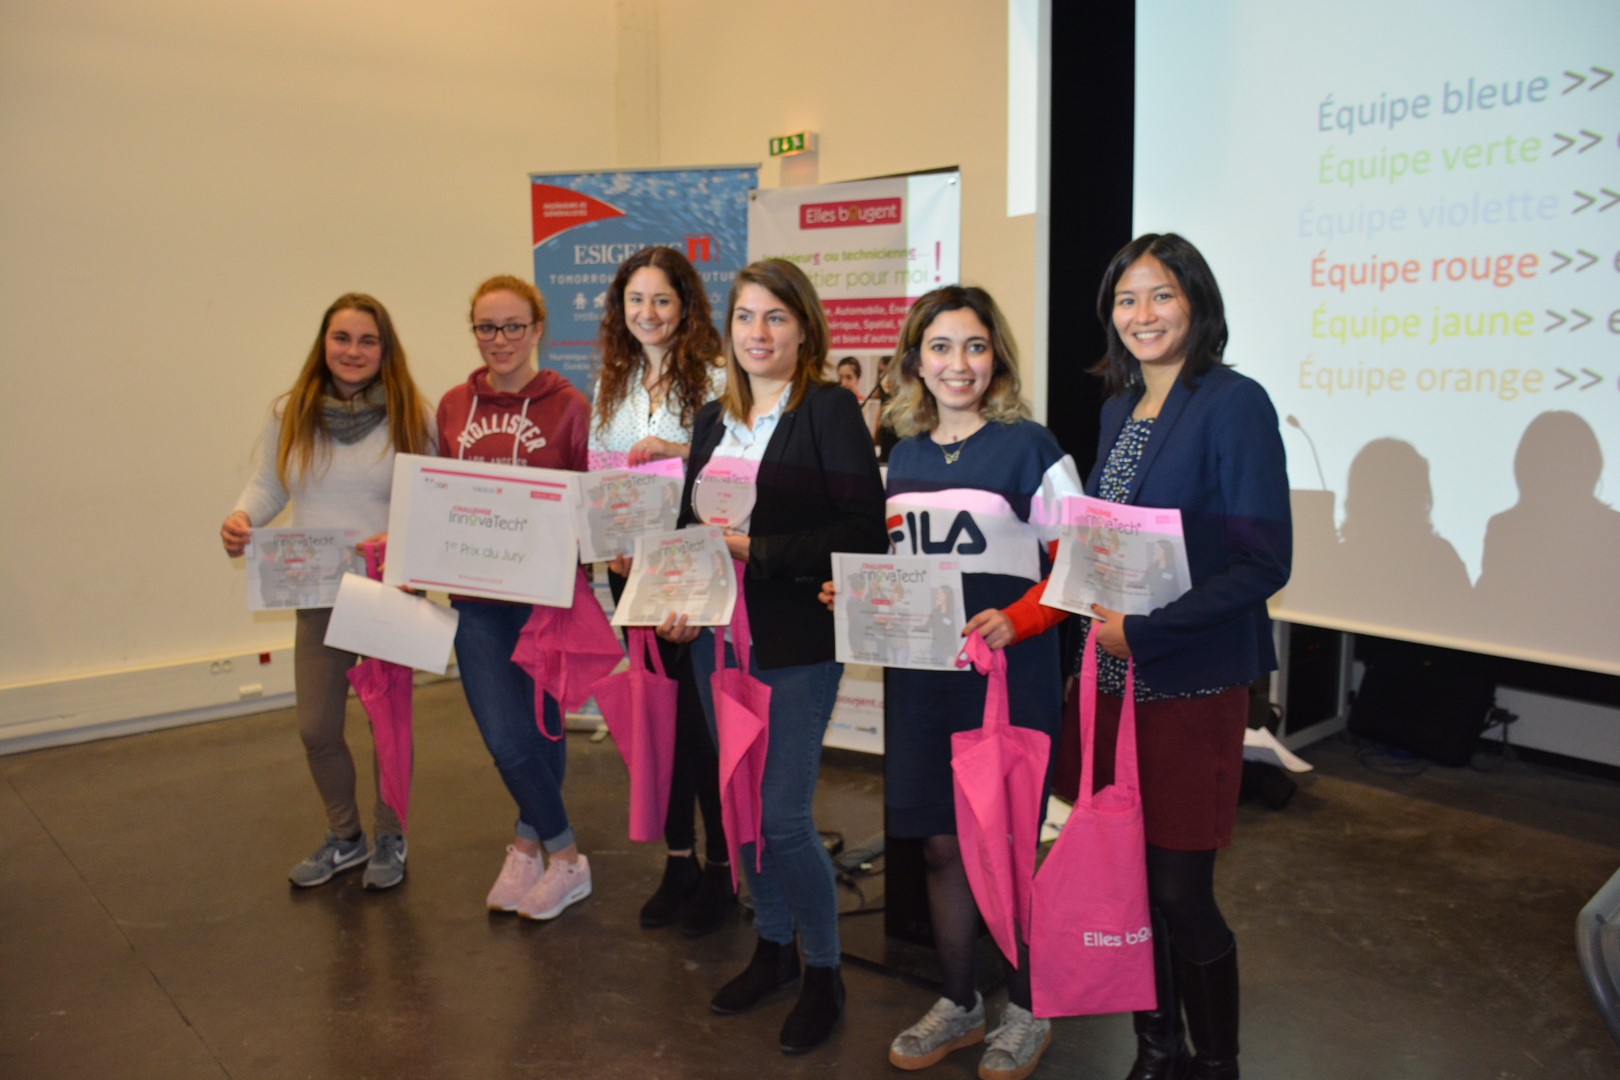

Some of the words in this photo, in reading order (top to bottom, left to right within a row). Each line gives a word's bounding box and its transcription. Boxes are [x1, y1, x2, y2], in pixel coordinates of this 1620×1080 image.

[1318, 93, 1431, 135] Équipe
[1442, 75, 1550, 115] bleue
[1319, 145, 1431, 188] Équipe
[1443, 134, 1542, 171] verte
[806, 208, 836, 224] Elles
[839, 205, 898, 223] bougent
[1298, 202, 1407, 240] Équipe
[1418, 190, 1560, 229] violette
[846, 270, 888, 290] pour
[895, 265, 929, 285] moi
[1310, 250, 1420, 293] Équipe
[1432, 252, 1540, 287] rouge
[1311, 303, 1421, 346] Équipe
[1428, 306, 1535, 346] jaune
[1298, 354, 1407, 397] Équipe
[1416, 366, 1544, 402] orange
[457, 412, 547, 453] HOLLISTER
[460, 542, 479, 556] Prix
[482, 546, 499, 559] du
[501, 549, 526, 564] Jury
[887, 510, 987, 555] FILA
[1083, 932, 1122, 947] Elles
